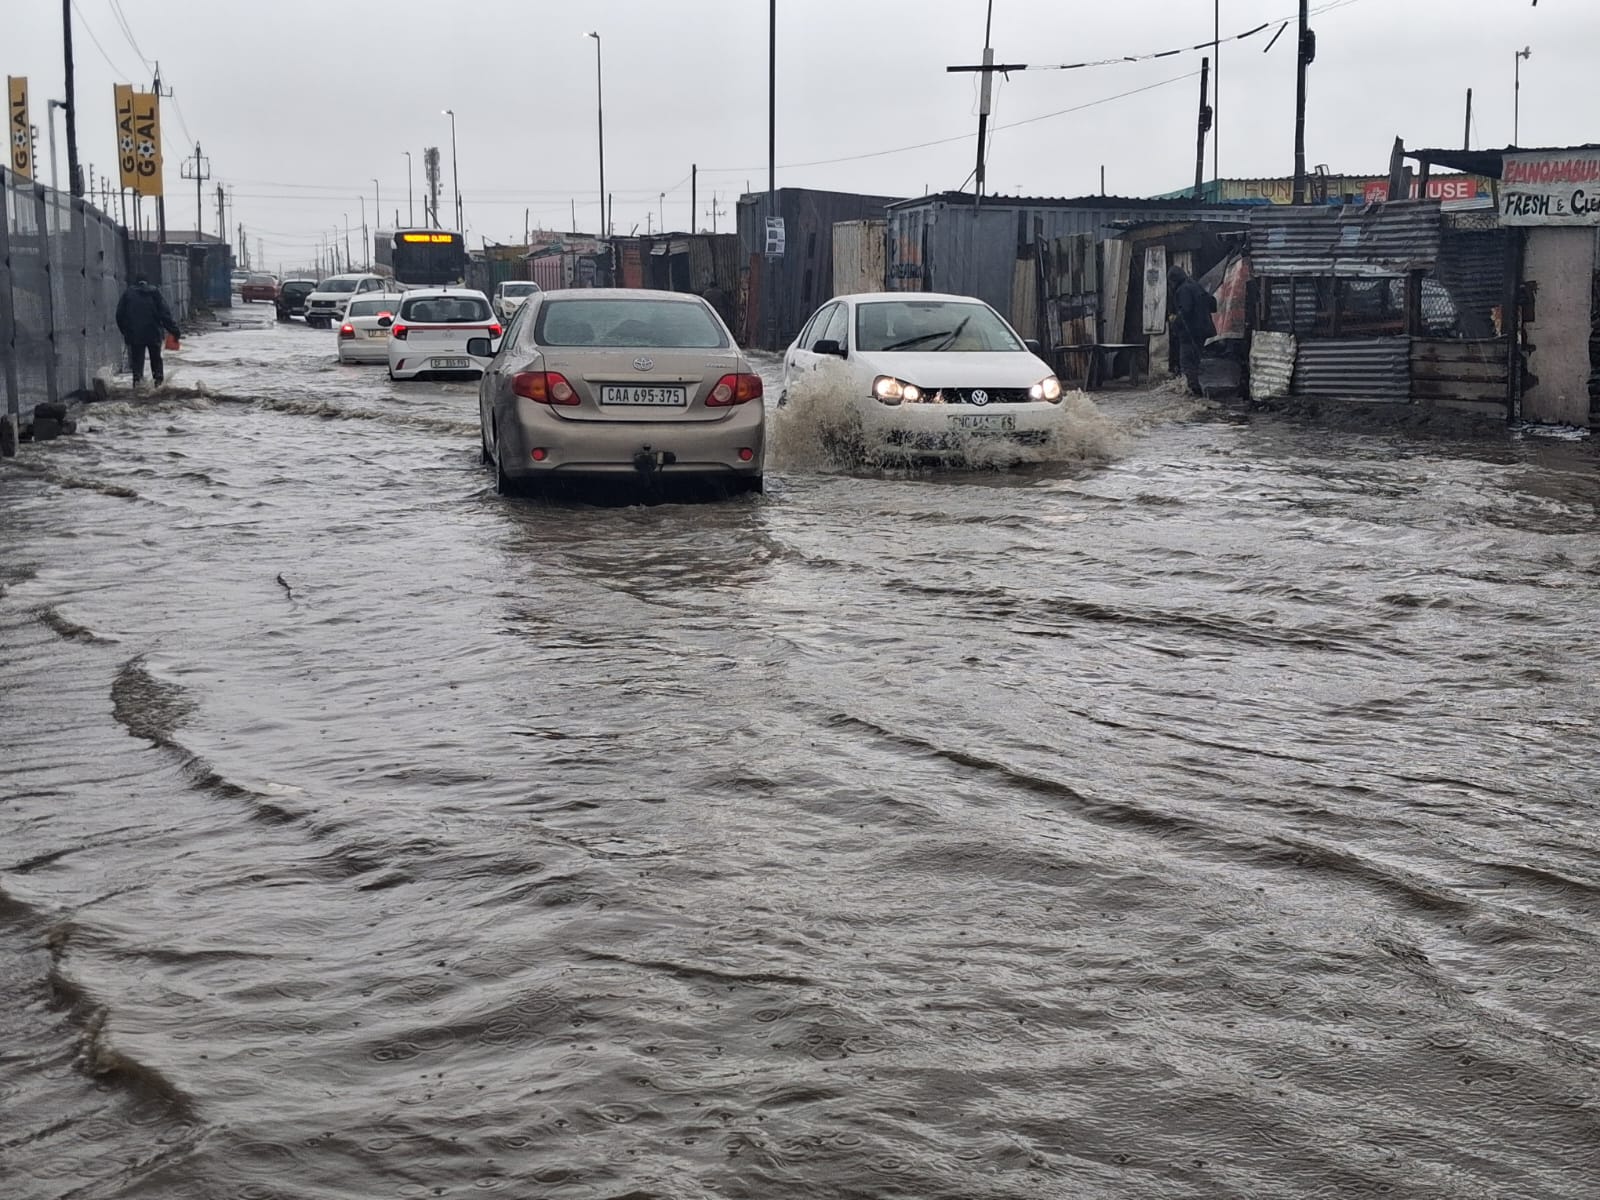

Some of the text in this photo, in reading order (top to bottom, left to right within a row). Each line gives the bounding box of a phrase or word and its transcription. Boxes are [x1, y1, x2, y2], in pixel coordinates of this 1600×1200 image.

[1504, 194, 1550, 216] FRESH
[1570, 189, 1600, 215] CLE
[608, 388, 680, 403] CAA 695-375
